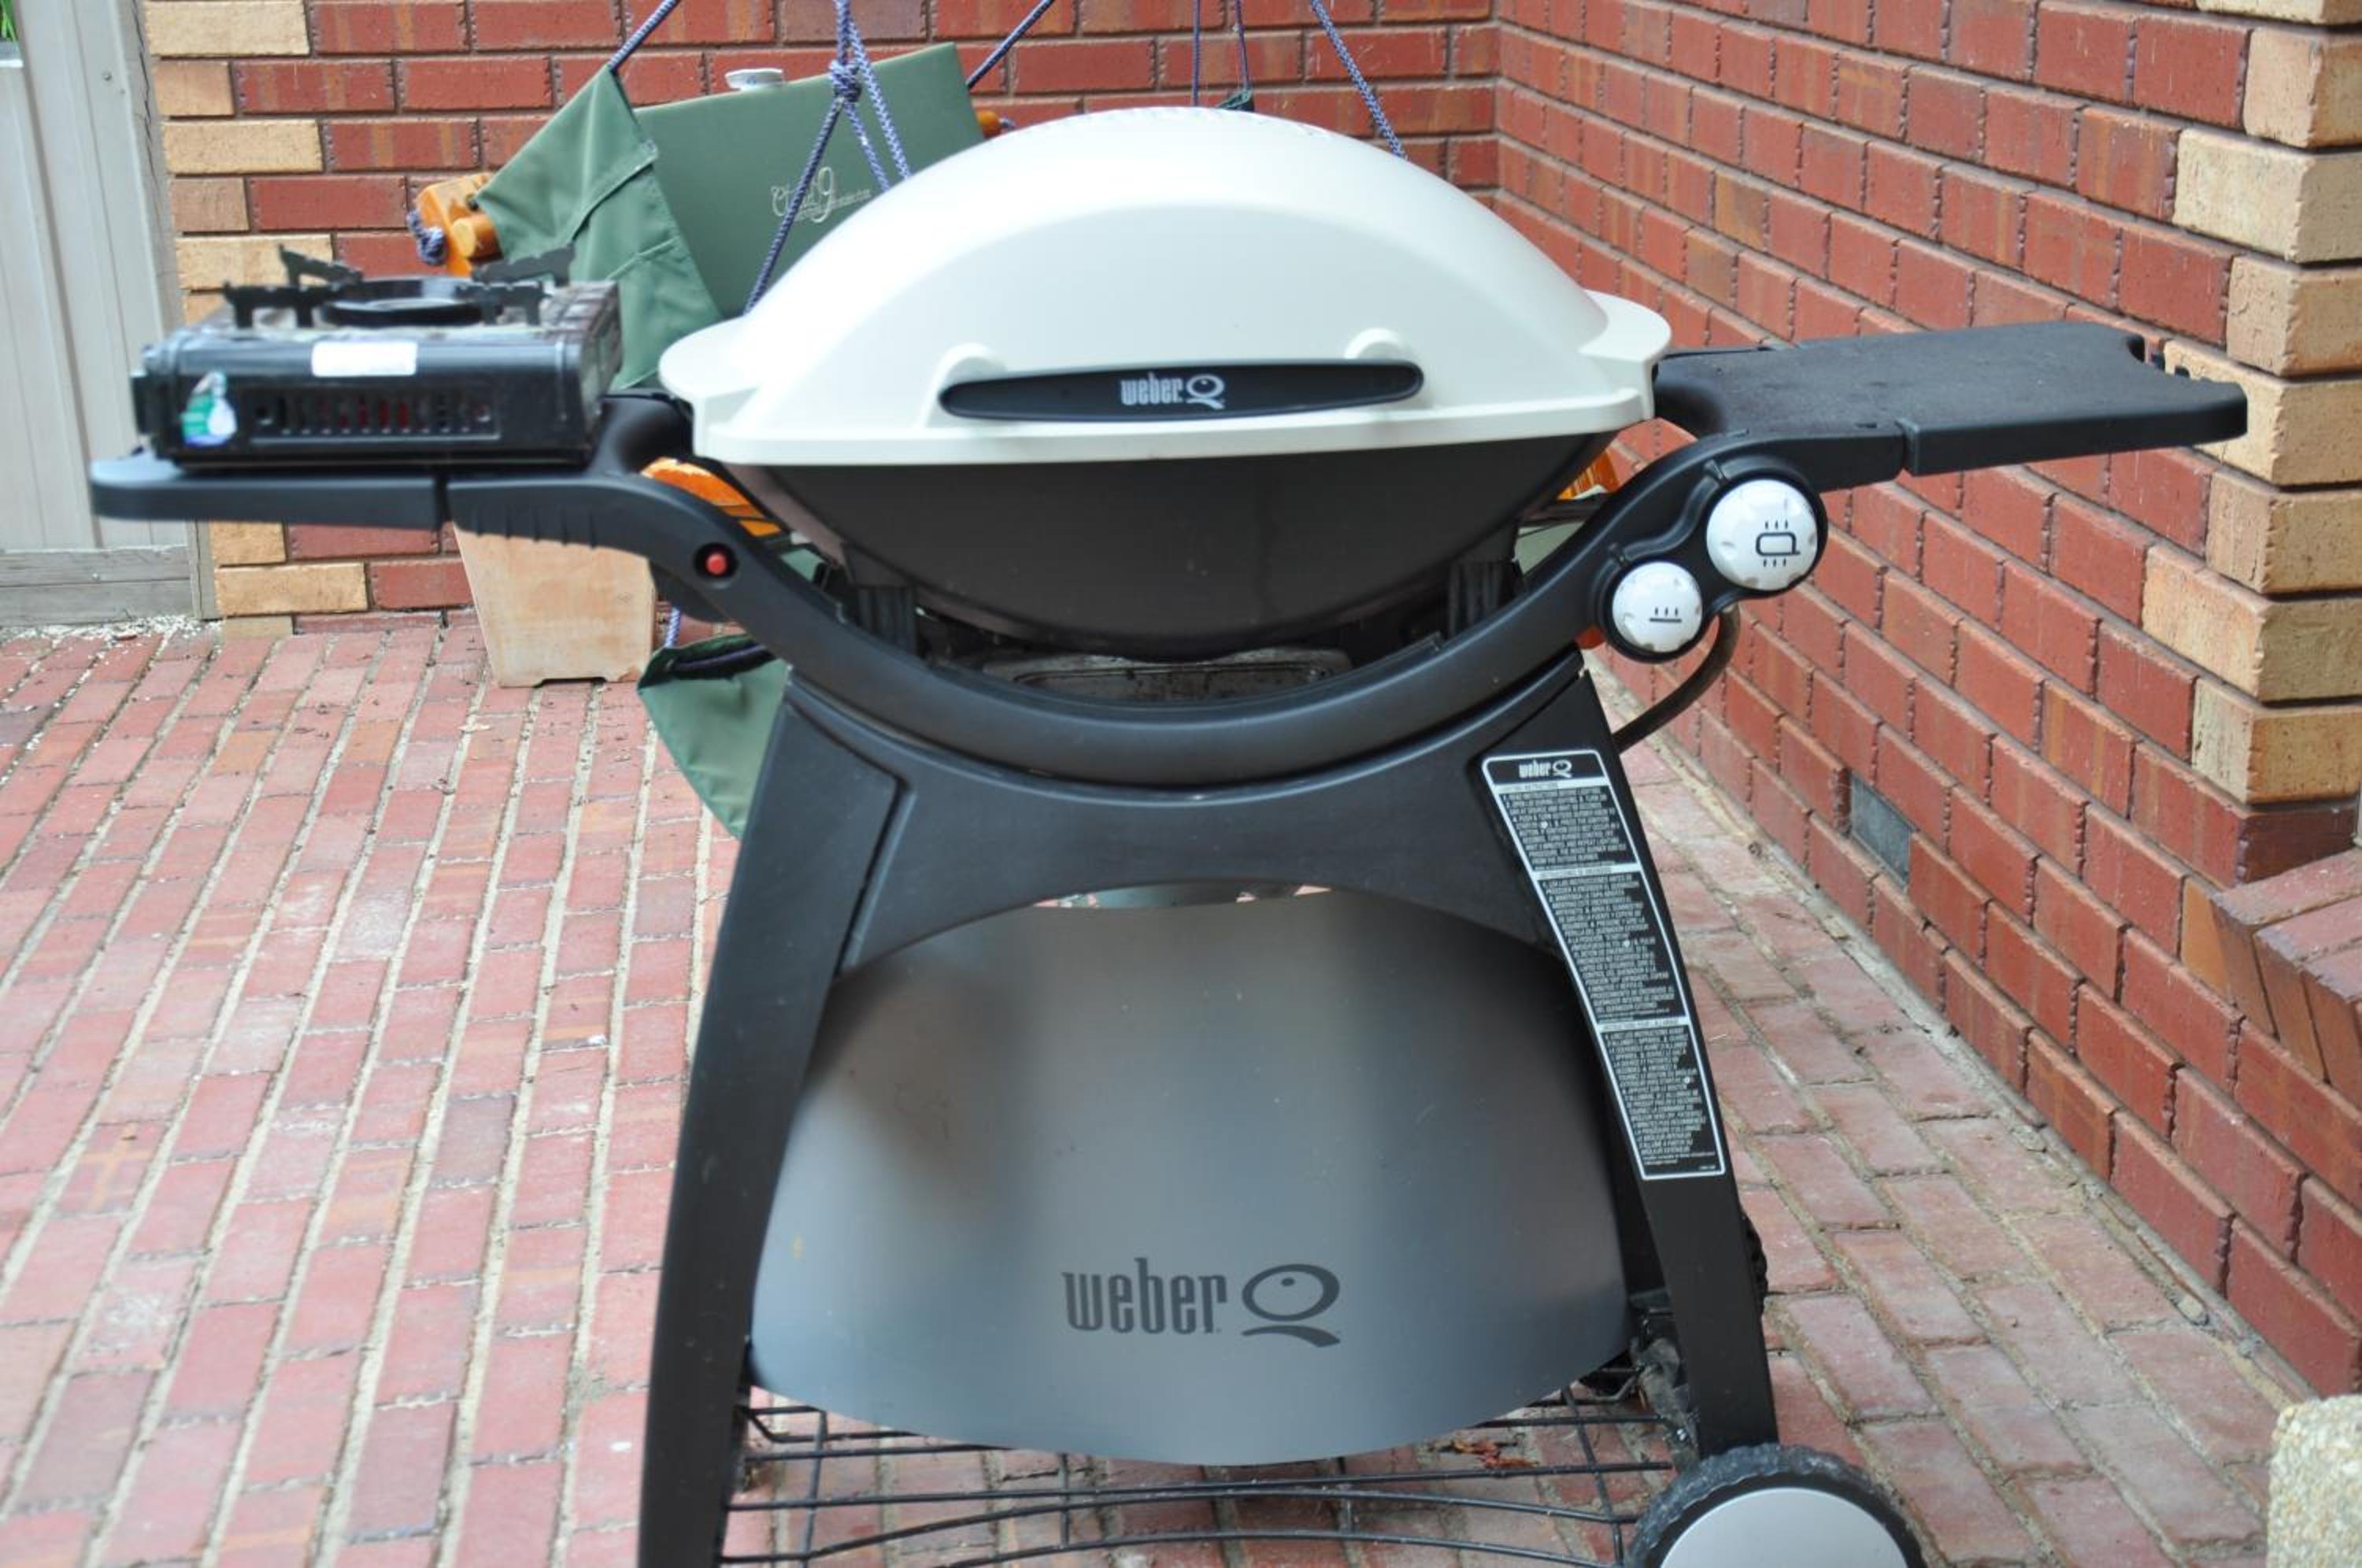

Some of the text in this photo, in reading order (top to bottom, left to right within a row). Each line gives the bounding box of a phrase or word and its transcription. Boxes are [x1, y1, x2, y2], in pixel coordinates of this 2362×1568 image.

[1120, 372, 1183, 405] weber
[1519, 760, 1551, 778] weber
[1061, 1257, 1228, 1334] weber
